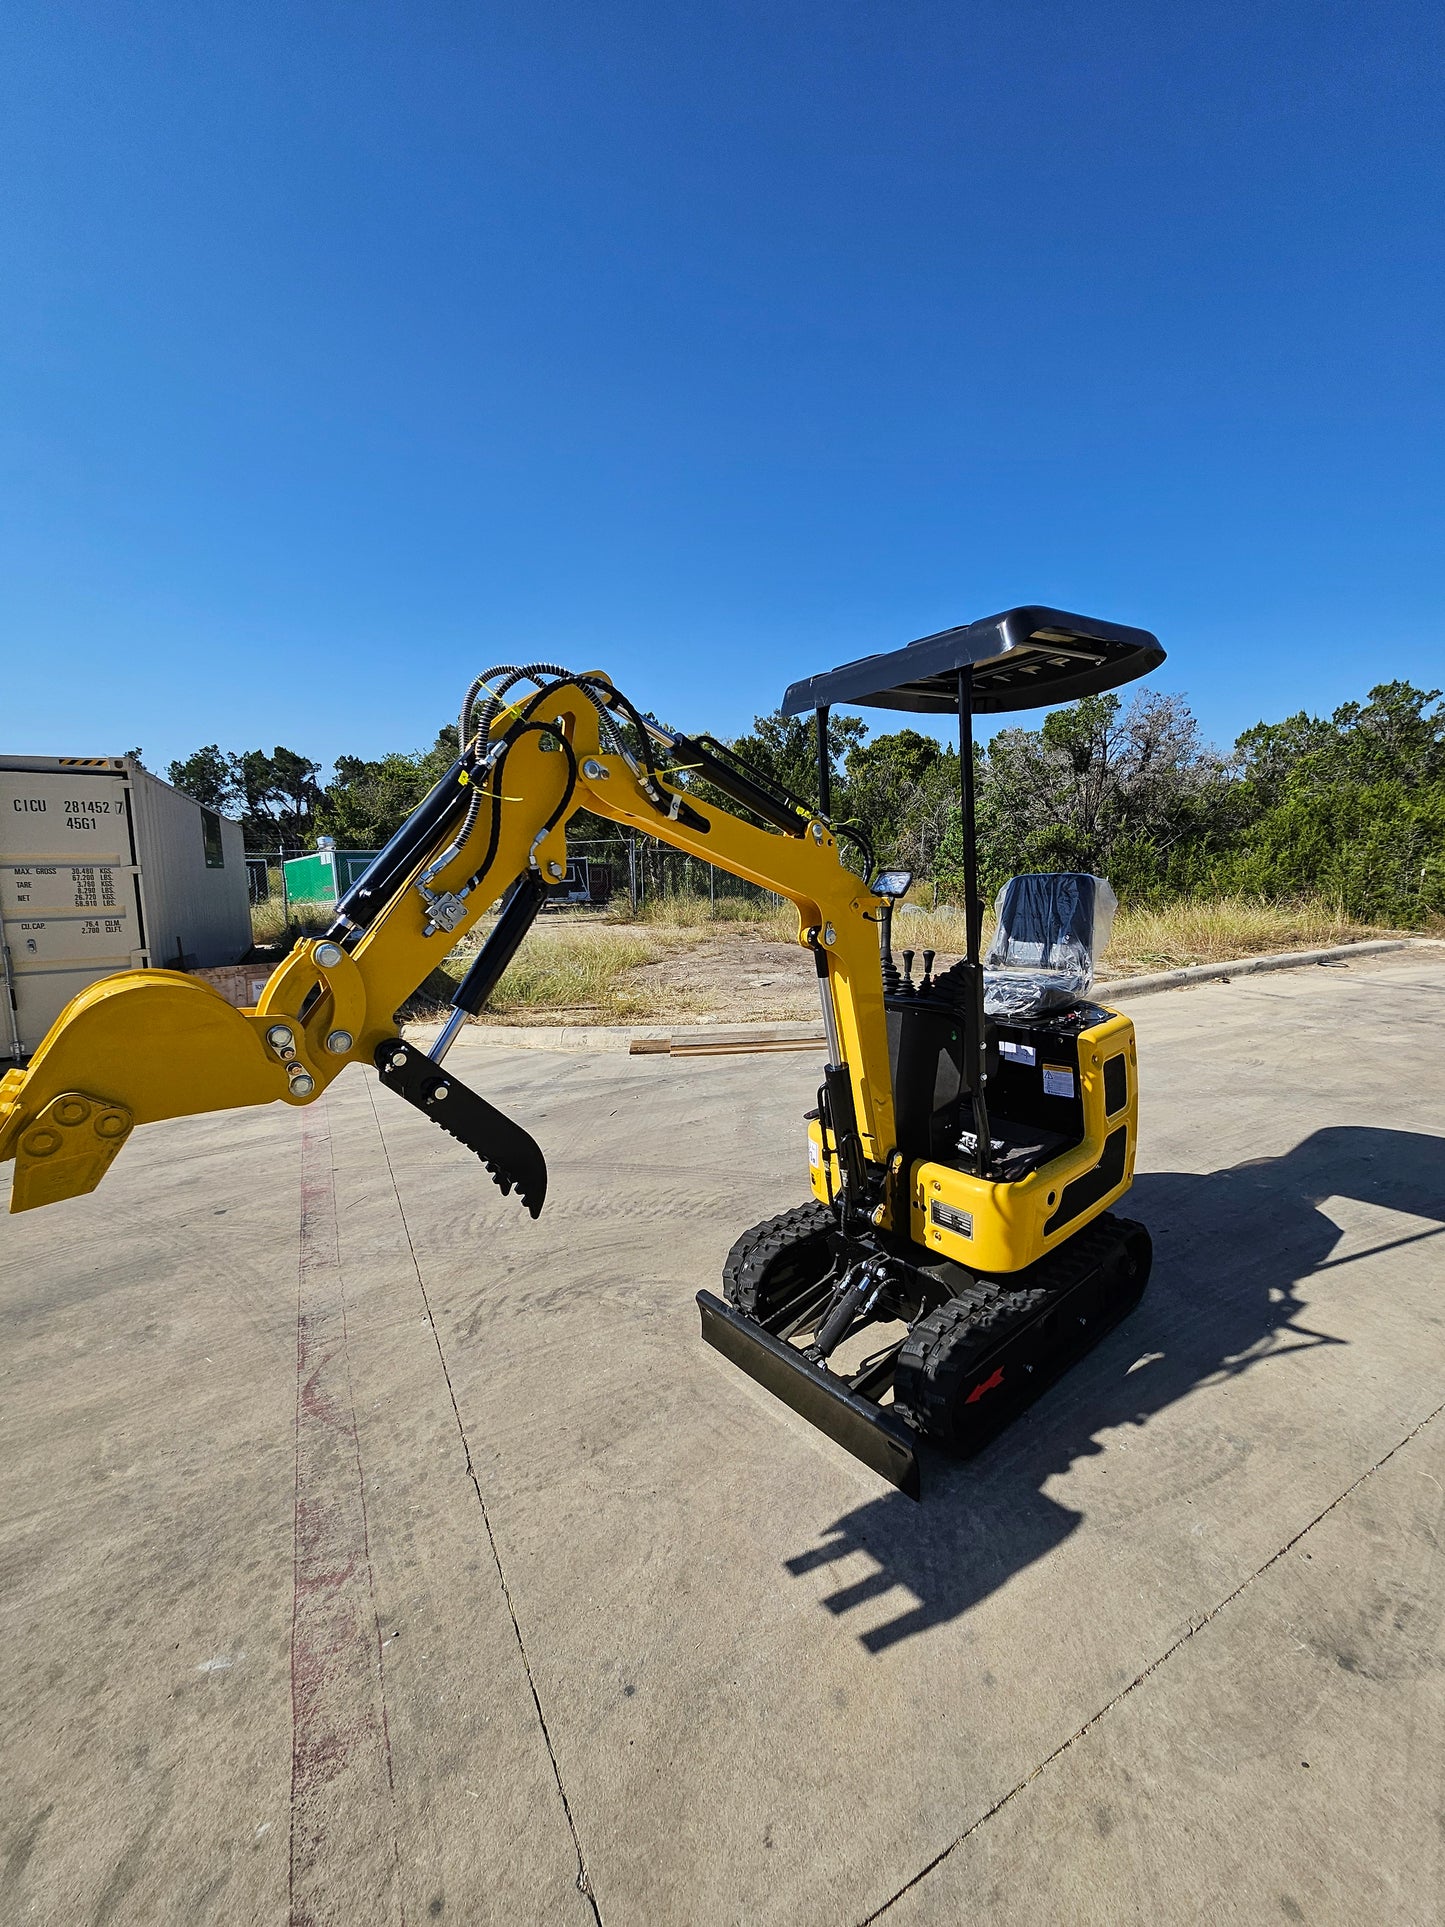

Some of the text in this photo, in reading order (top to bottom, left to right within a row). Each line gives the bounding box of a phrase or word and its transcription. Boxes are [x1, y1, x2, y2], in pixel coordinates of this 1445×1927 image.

[14, 799, 124, 814] CICU 281452 7
[66, 817, 96, 830] 45G1
